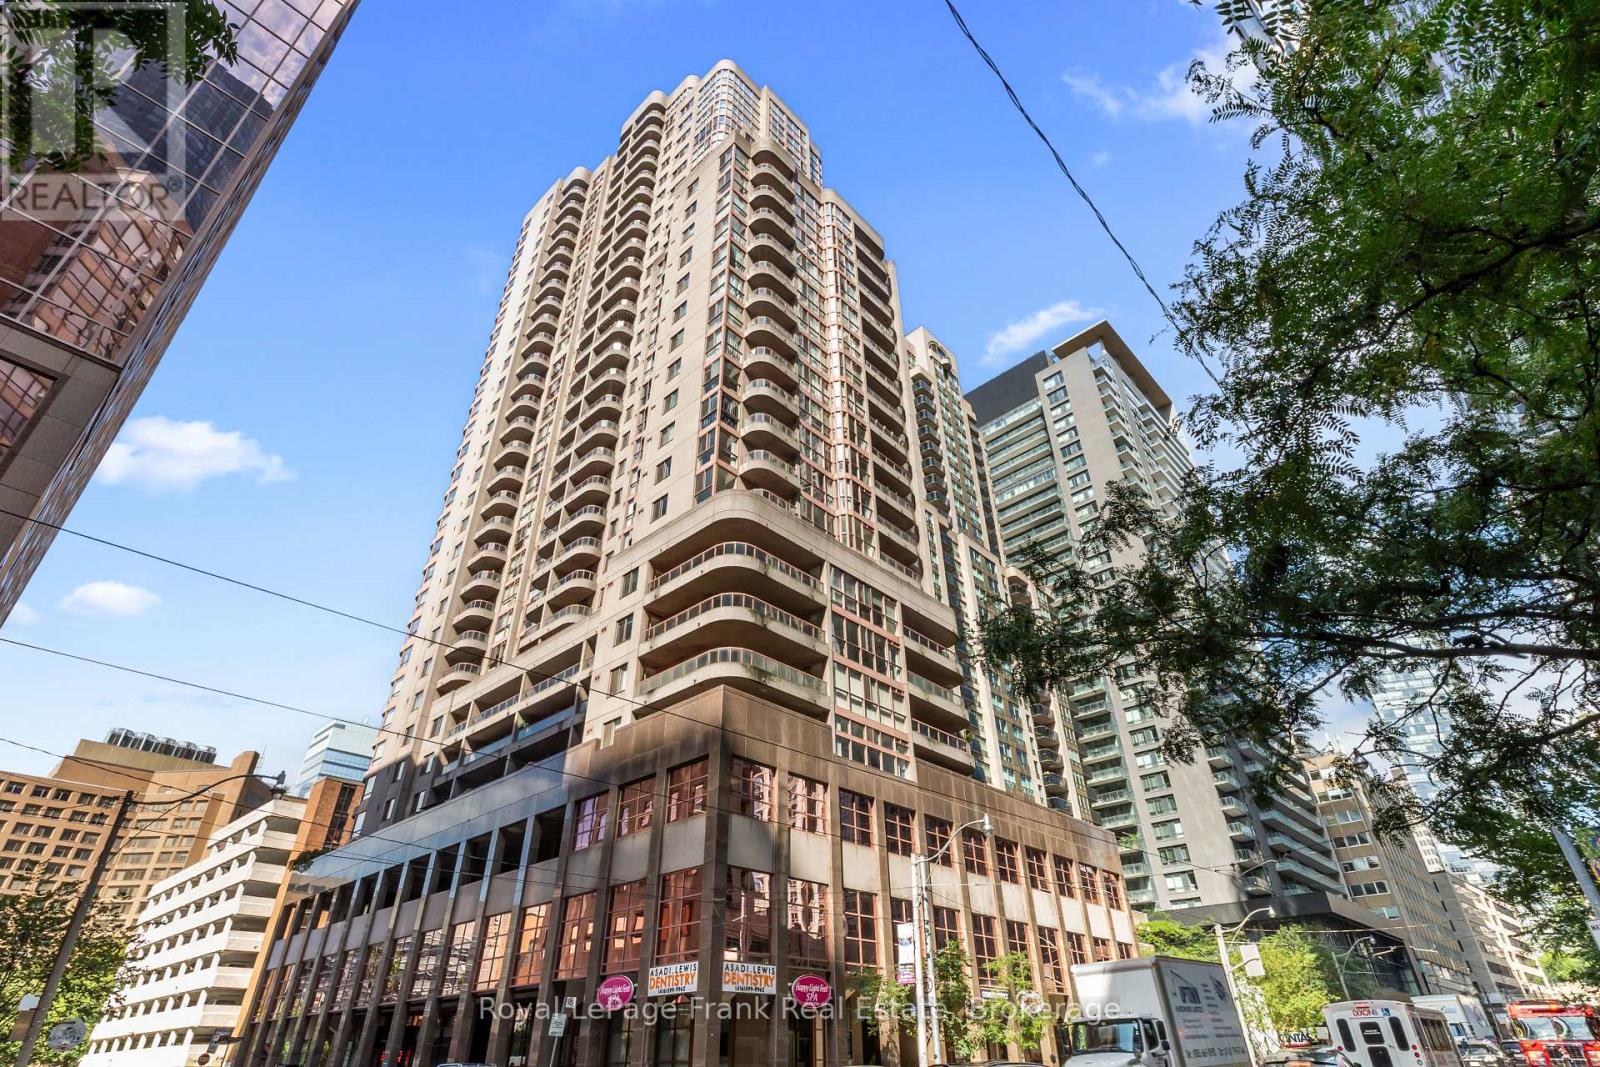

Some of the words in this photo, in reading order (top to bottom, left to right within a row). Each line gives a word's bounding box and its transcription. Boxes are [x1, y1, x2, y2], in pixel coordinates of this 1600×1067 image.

[649, 971, 697, 990] DENTISTRY
[723, 971, 775, 988] DENTISTRY
[795, 982, 808, 993] Happy
[805, 992, 818, 1002] SPA
